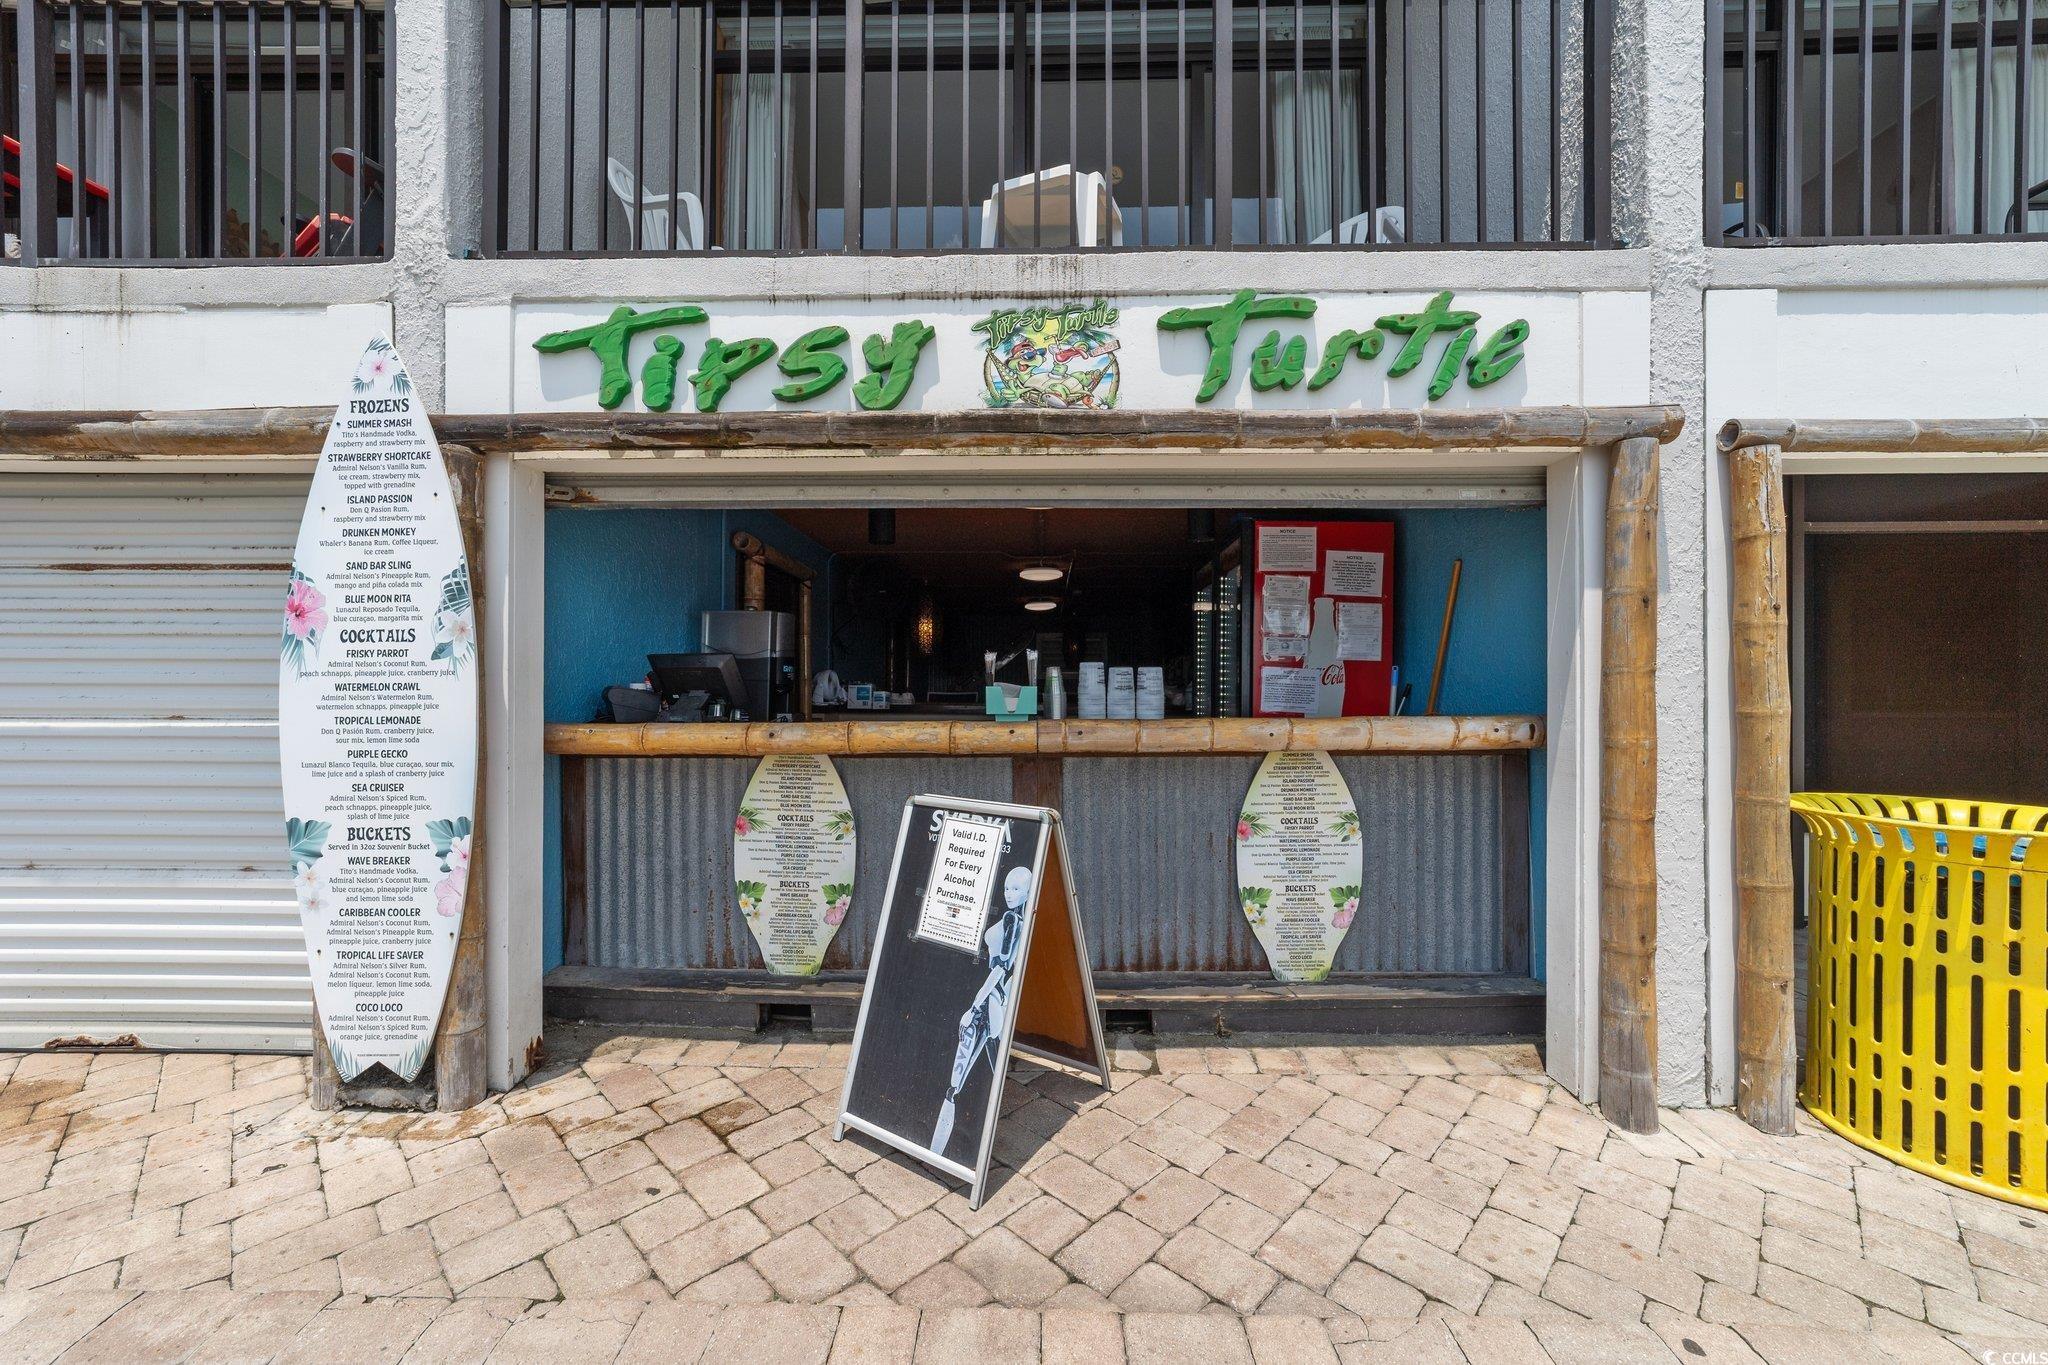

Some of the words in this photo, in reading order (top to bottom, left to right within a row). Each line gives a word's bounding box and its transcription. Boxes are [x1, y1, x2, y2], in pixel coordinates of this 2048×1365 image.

[1048, 299, 1119, 341] Turtle
[1157, 288, 1530, 403] Turtle
[350, 398, 410, 414] FROZENS
[347, 419, 382, 429] SUMMER
[384, 418, 412, 428] SMASH
[334, 441, 364, 449] raspberry
[379, 440, 413, 448] strawberry
[328, 453, 383, 462] STRAWBERRY
[384, 451, 431, 461] SHORTCAKE
[332, 464, 358, 472] Admiral
[372, 473, 406, 481] strawberry
[344, 483, 366, 492] topped
[383, 482, 416, 490] grenadine
[347, 495, 376, 505] ISLAND
[378, 494, 412, 504] PASSION
[334, 516, 364, 525] raspberry
[379, 515, 413, 523] strawberry
[342, 528, 380, 538] DRUNKEN
[381, 527, 416, 537] MONKEY
[392, 538, 412, 546] Coffee
[346, 561, 368, 571] SAND
[370, 561, 386, 570] BAR
[388, 560, 412, 570] SLING
[334, 583, 357, 591] mango
[345, 594, 366, 604] BLUE
[366, 594, 392, 604] MOON
[394, 594, 412, 603] RITA
[362, 606, 394, 614] Reposado
[333, 615, 348, 623] blue
[378, 615, 410, 623] margarita
[340, 628, 416, 643] COCKTAILS
[346, 649, 375, 658] FRISKY
[376, 649, 409, 658] PARROT
[334, 682, 390, 692] WATERMELON
[392, 682, 421, 692] CRAWL
[390, 703, 422, 712] pineapple
[423, 703, 440, 711] juice
[334, 716, 375, 725] TROPICAL
[376, 716, 421, 725] LEMONADE
[388, 736, 403, 744] lime
[347, 749, 380, 759] PURPLE
[380, 749, 408, 759] GECKO
[327, 771, 344, 780] juice
[344, 770, 358, 778] and
[365, 770, 386, 778] splash
[428, 770, 445, 778] juice
[352, 783, 368, 793] SEA
[369, 783, 404, 792] CRUISER
[346, 813, 368, 821] splash
[393, 813, 410, 821] juice
[1280, 817, 1318, 825] COCKTAILS
[346, 826, 412, 841] BUCKETS
[953, 828, 972, 840] Valid
[973, 832, 988, 843] I.D.
[352, 843, 358, 851] in
[360, 843, 376, 851] 32oz
[948, 843, 985, 858] Required
[347, 856, 371, 866] WAVE
[372, 856, 412, 866] BREAKER
[944, 857, 958, 868] For
[958, 860, 982, 874] Every
[943, 873, 975, 888] Alcohol
[377, 886, 410, 894] pineapple
[410, 886, 428, 894] juice
[936, 886, 976, 904] Purchase.
[339, 908, 386, 917] CARIBBEAN
[387, 908, 421, 917] COOLER
[329, 938, 362, 947] pineapple
[382, 938, 414, 946] cranberry
[415, 938, 432, 947] juice
[336, 950, 377, 960] TROPICAL
[378, 950, 395, 960] LIFE
[396, 950, 424, 960] SAVER
[354, 990, 388, 998] pineapple
[388, 990, 404, 998] juice
[356, 1003, 379, 1013] COCO
[380, 1003, 403, 1012] LOCO
[340, 1034, 363, 1042] orange
[384, 1033, 418, 1042] grenadine
